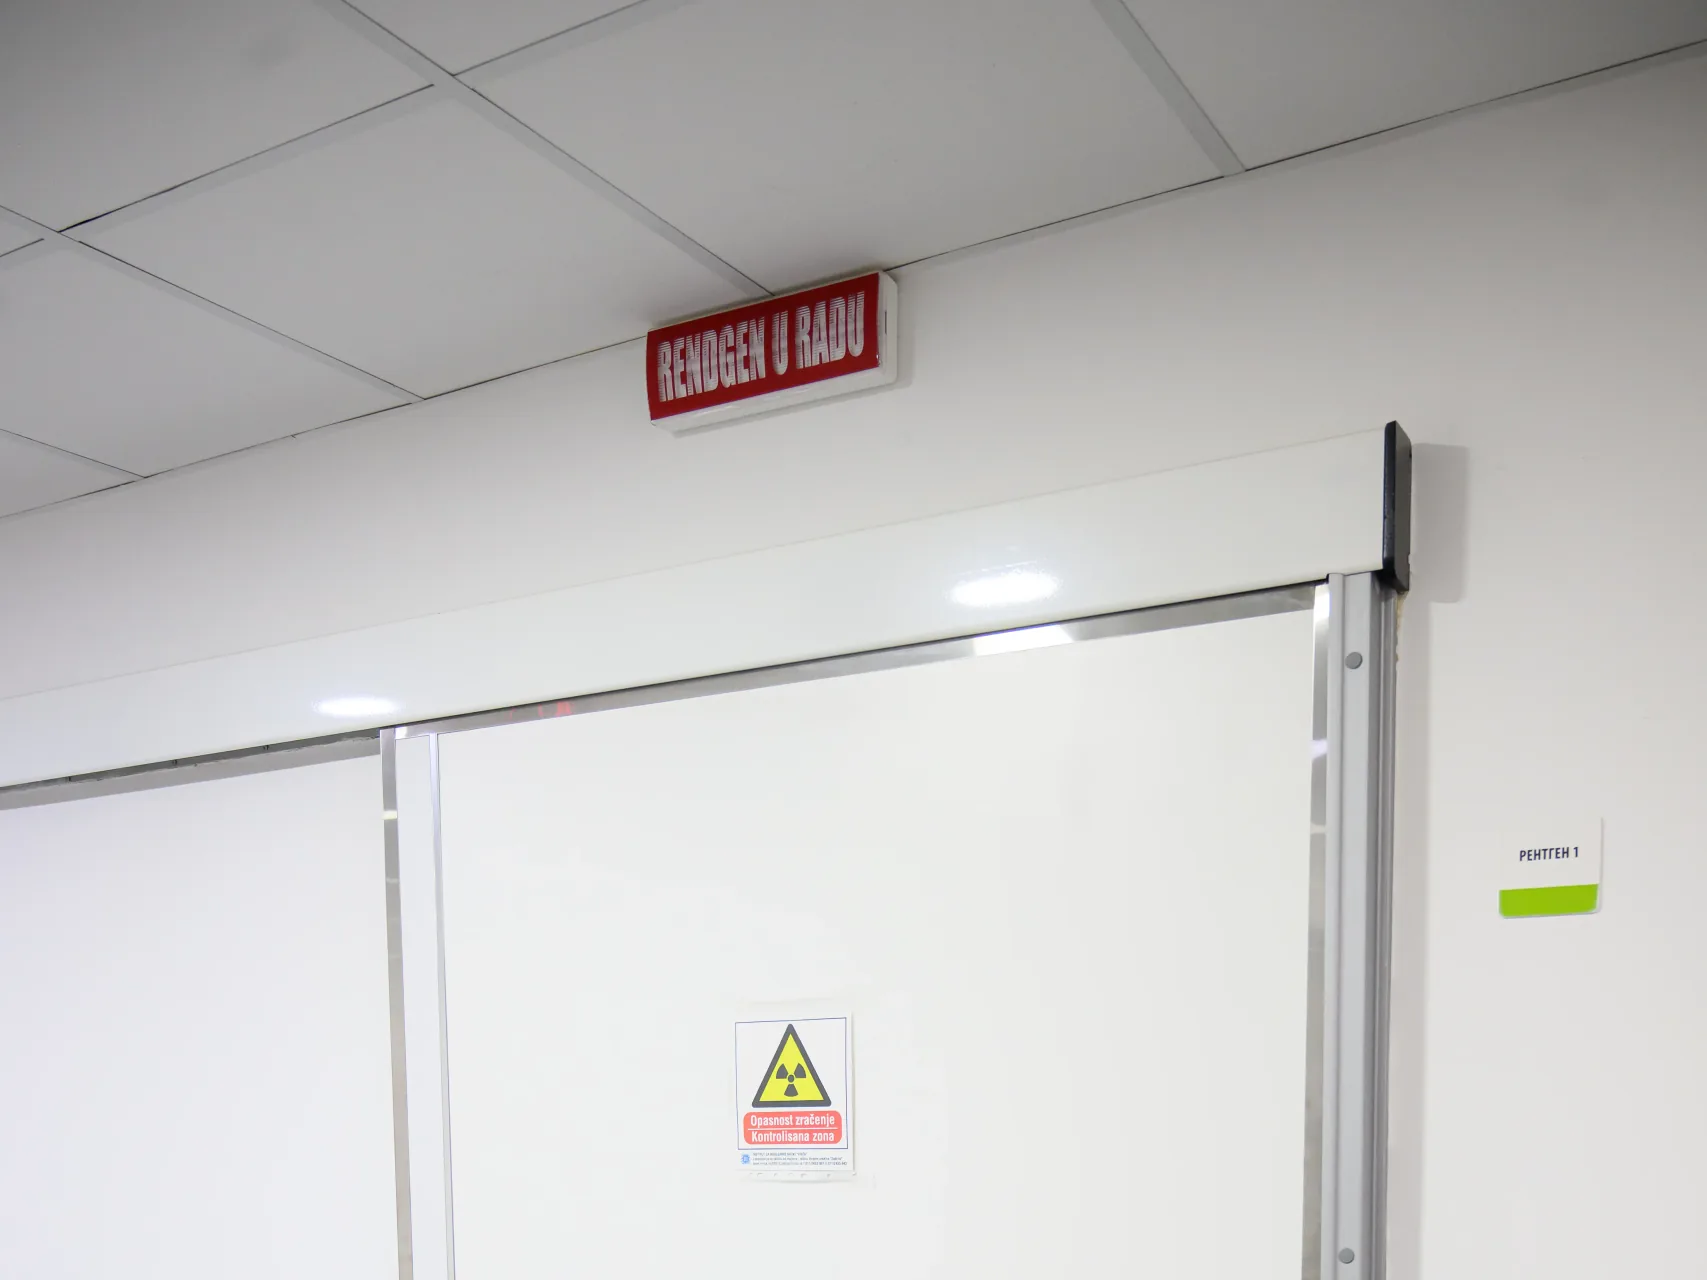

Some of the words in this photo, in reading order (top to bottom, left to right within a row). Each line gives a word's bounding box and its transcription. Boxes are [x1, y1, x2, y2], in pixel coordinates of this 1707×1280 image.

[657, 316, 766, 402] RENDGEN
[771, 310, 789, 376] U
[795, 291, 865, 370] RADU
[1519, 846, 1570, 862] РЕНТГЕН
[1573, 846, 1579, 858] 1
[750, 1114, 793, 1128] Opasnost
[795, 1113, 835, 1128] zračenje
[751, 1130, 810, 1143] Kontrolisana
[812, 1132, 835, 1142] zona
